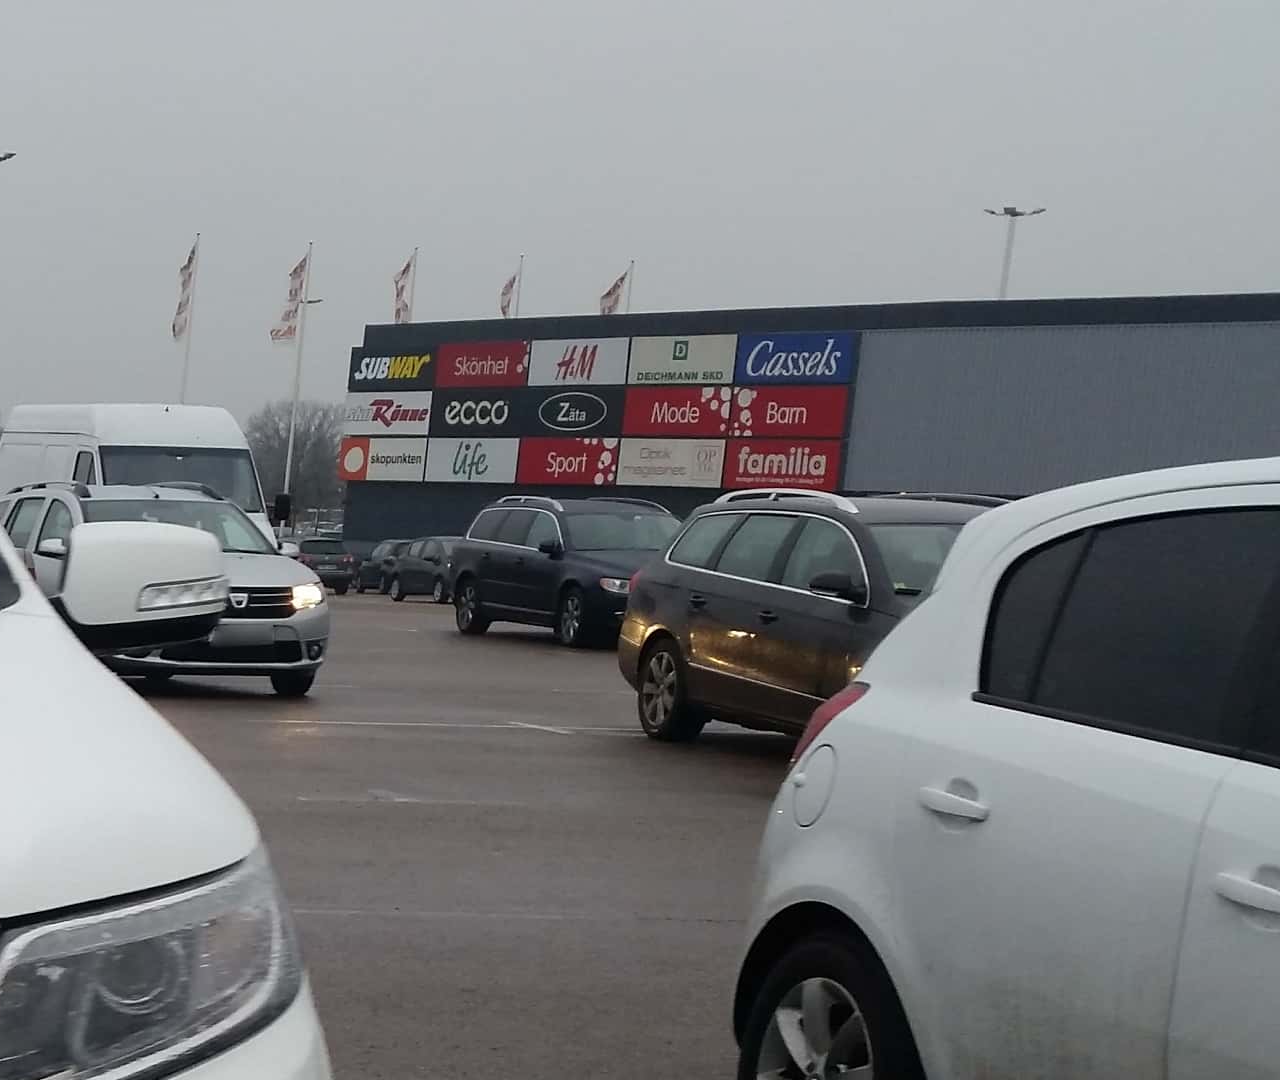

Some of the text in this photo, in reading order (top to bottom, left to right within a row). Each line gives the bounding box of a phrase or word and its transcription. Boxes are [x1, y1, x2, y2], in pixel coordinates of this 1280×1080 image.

[675, 343, 686, 357] D
[746, 339, 842, 377] Cassels
[354, 354, 430, 380] SUBWAY
[454, 355, 509, 376] Skönhet
[555, 344, 598, 380] H&M
[637, 371, 698, 381] DEICHMANN
[445, 400, 509, 425] ecco
[557, 402, 587, 422] Zäta
[650, 401, 700, 424] Mode
[766, 402, 807, 424] Barn
[370, 453, 422, 466] skopunkten
[545, 451, 588, 477] Sport
[738, 446, 827, 476] familia
